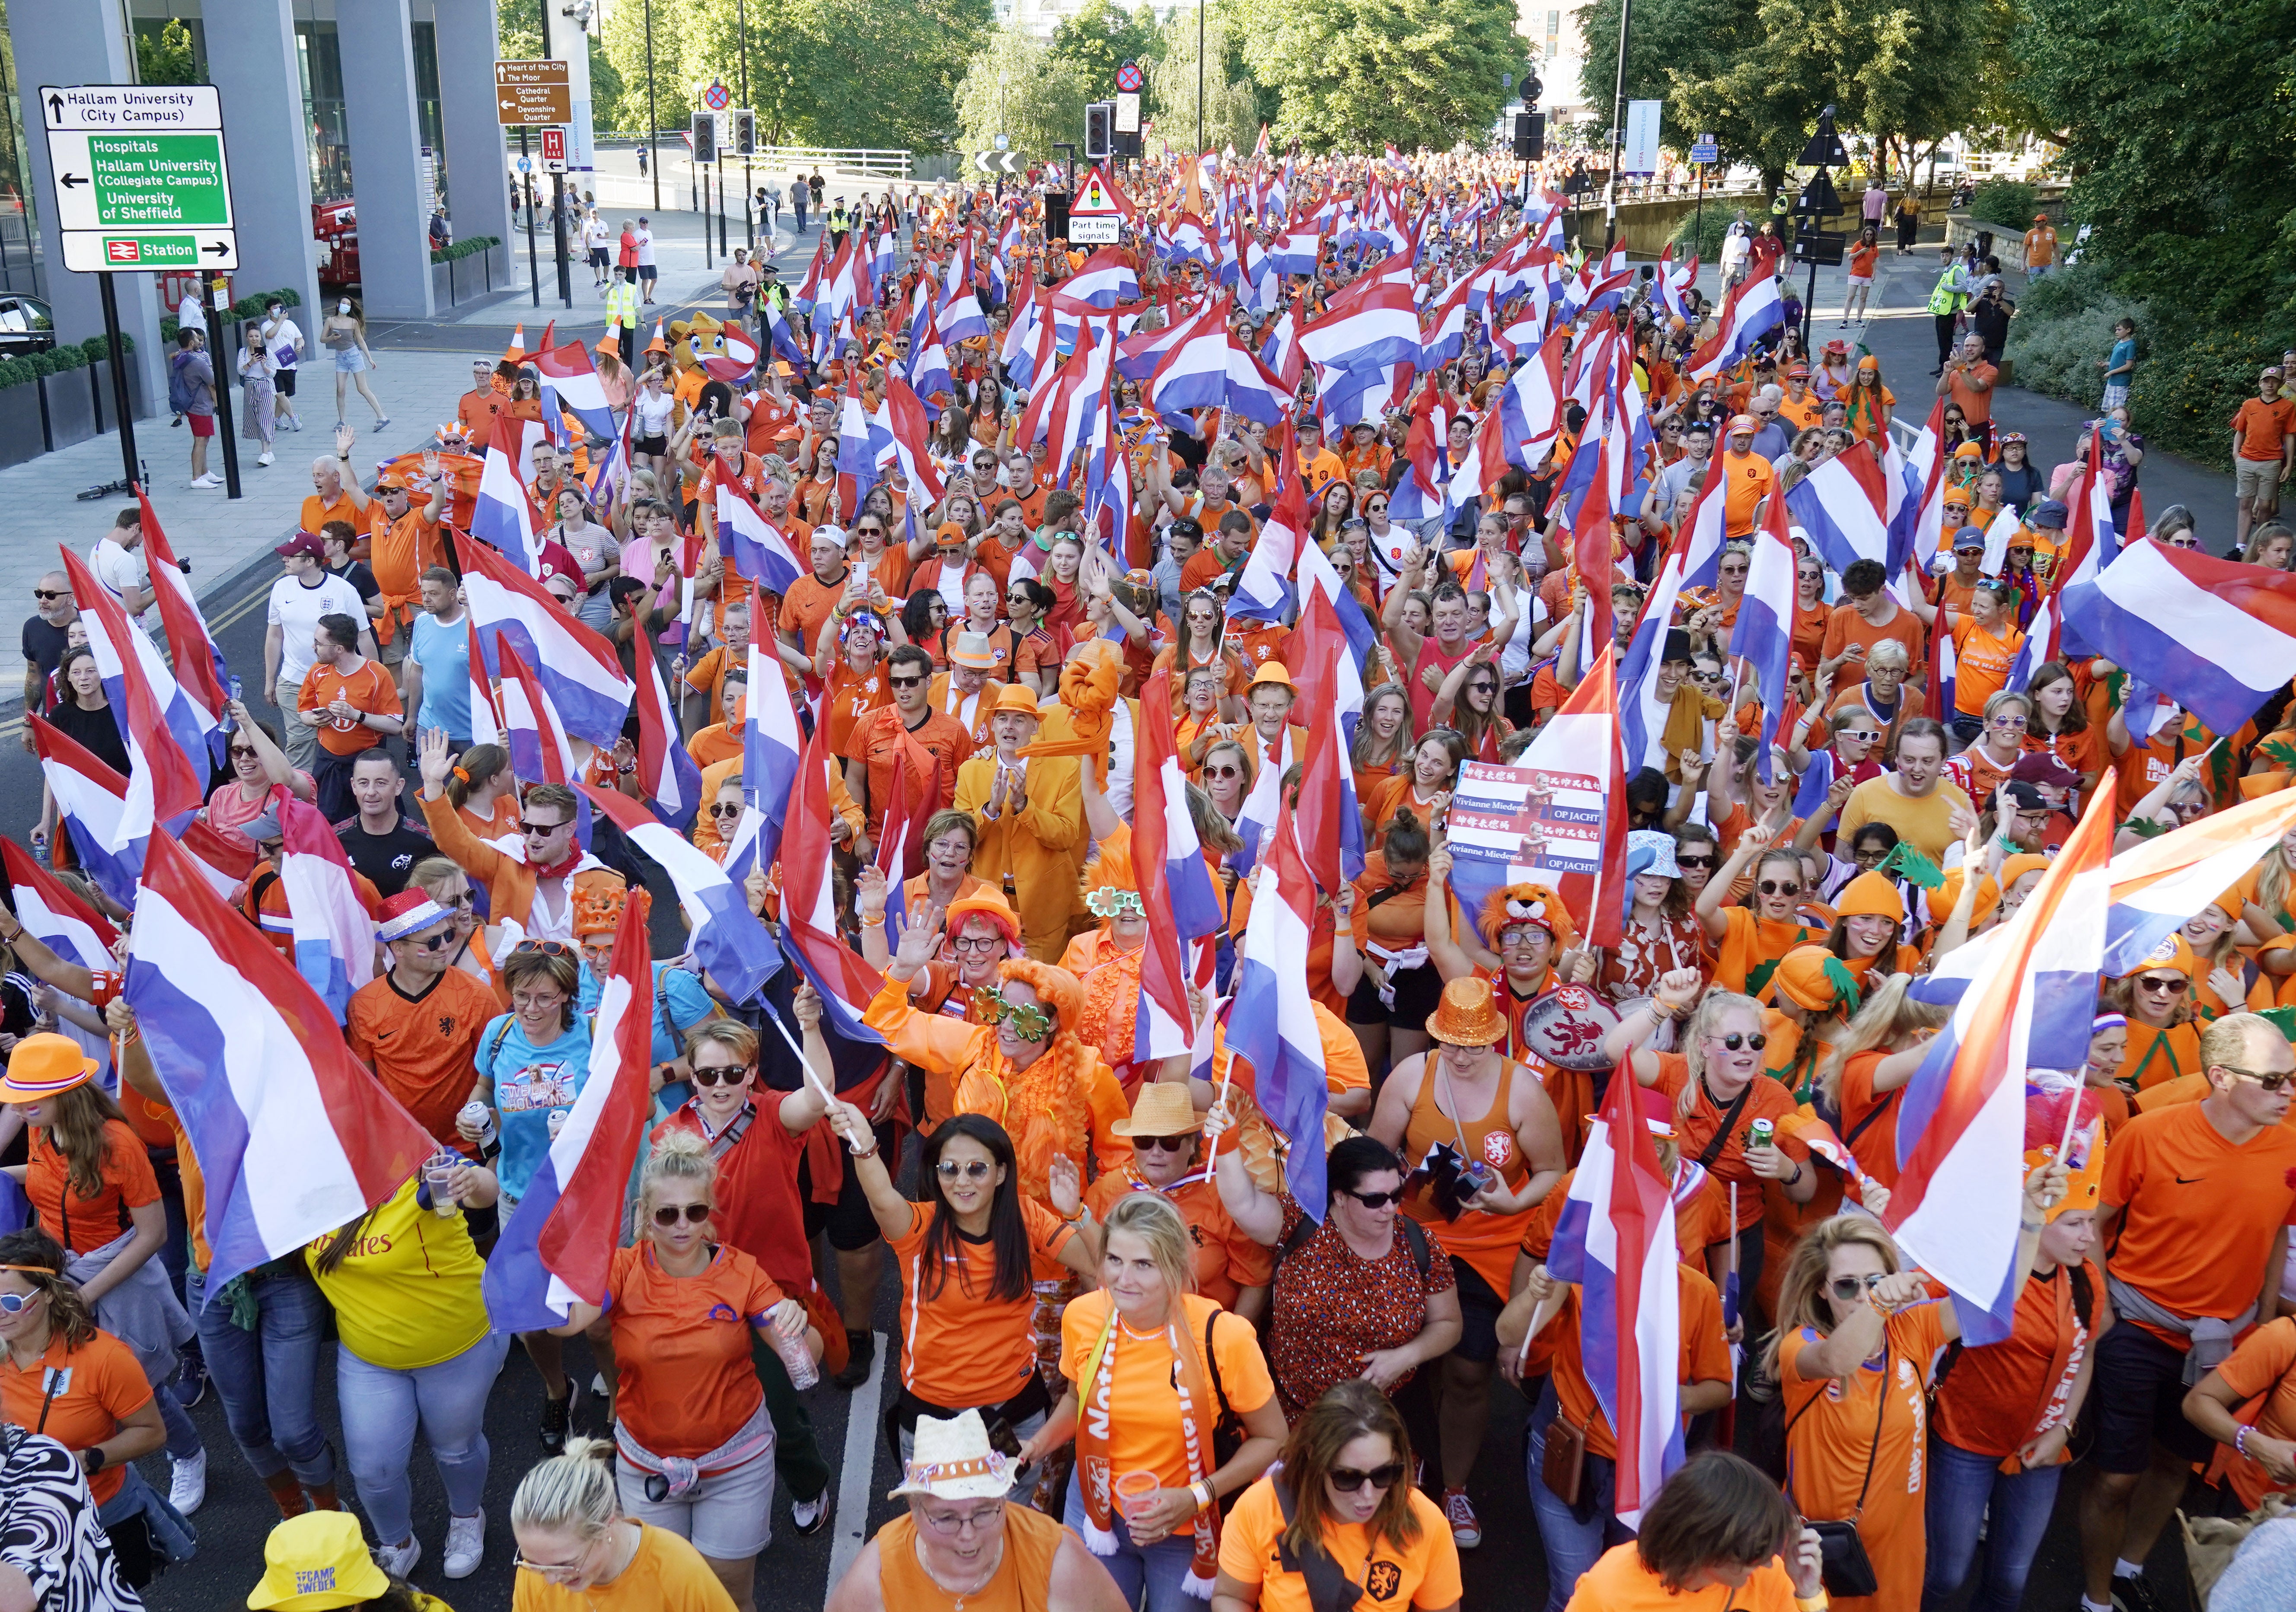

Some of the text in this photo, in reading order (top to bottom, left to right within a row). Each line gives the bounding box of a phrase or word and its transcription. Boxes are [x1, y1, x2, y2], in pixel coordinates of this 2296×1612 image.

[551, 63, 566, 72] City
[68, 93, 193, 106] Hallam University
[81, 109, 184, 123] (City Campus)
[93, 140, 159, 154] Hospitals
[548, 134, 558, 149] H
[96, 159, 217, 173] Hallam University
[98, 175, 218, 188] (Collegiate Campus)
[107, 192, 174, 206] University
[102, 207, 182, 219] of Sheffield
[1078, 232, 1110, 241] signals
[143, 243, 193, 256] Station
[805, 498, 811, 512] 5
[1962, 657, 2007, 672] DEN HAAG
[851, 697, 868, 717] 12
[1455, 796, 1528, 812] Vivianne Miedema
[1554, 810, 1599, 822] OP JACHT
[1447, 844, 1523, 862] Vivianne Miedema
[1549, 860, 1596, 872] OP JACHT
[942, 1009, 964, 1021] HOLLAND
[508, 1081, 563, 1097] WE LOVE
[507, 1091, 569, 1111] HOLLAND
[307, 1234, 392, 1257] mates
[307, 1566, 335, 1582] CAMP
[297, 1577, 336, 1594] SWEDEN
